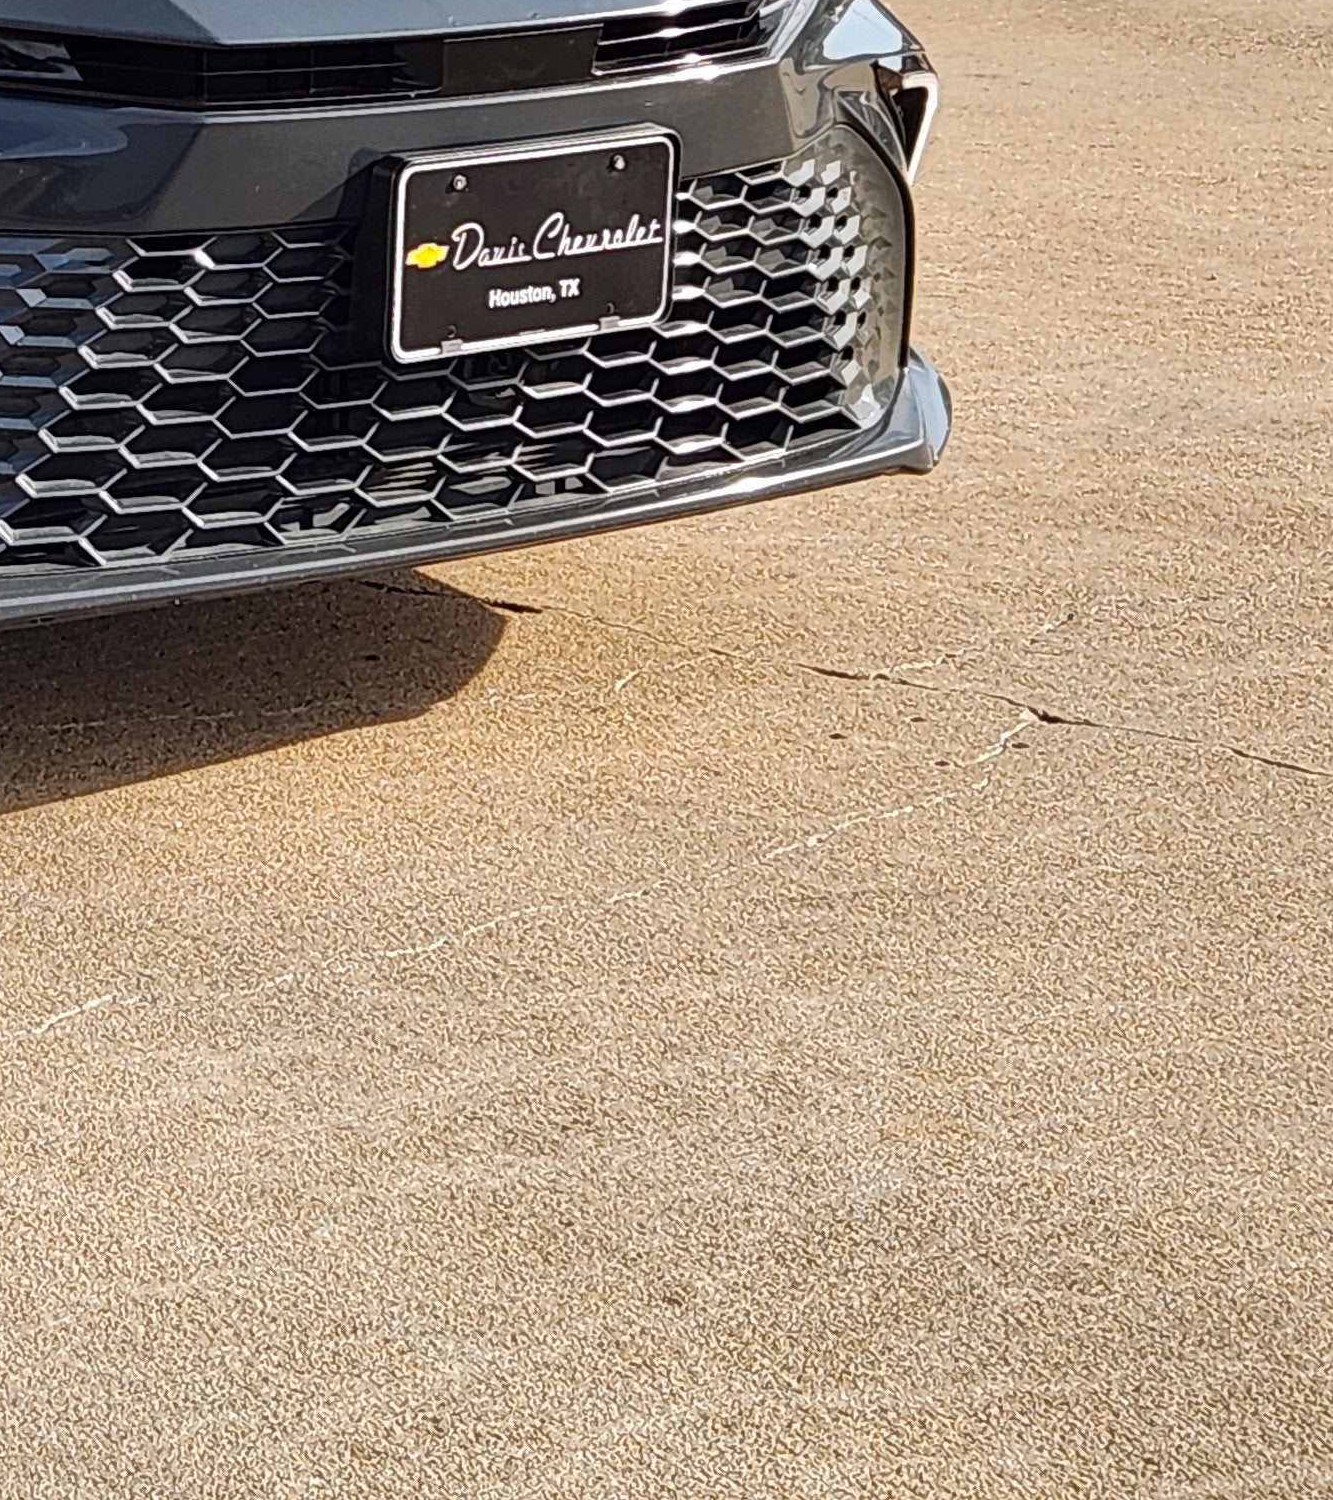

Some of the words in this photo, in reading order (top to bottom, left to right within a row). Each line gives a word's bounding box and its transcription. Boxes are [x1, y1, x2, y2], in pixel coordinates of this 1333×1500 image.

[451, 221, 532, 270] Davis
[533, 211, 664, 260] Chevrolet
[488, 285, 556, 309] Houston,
[558, 277, 581, 298] TX
